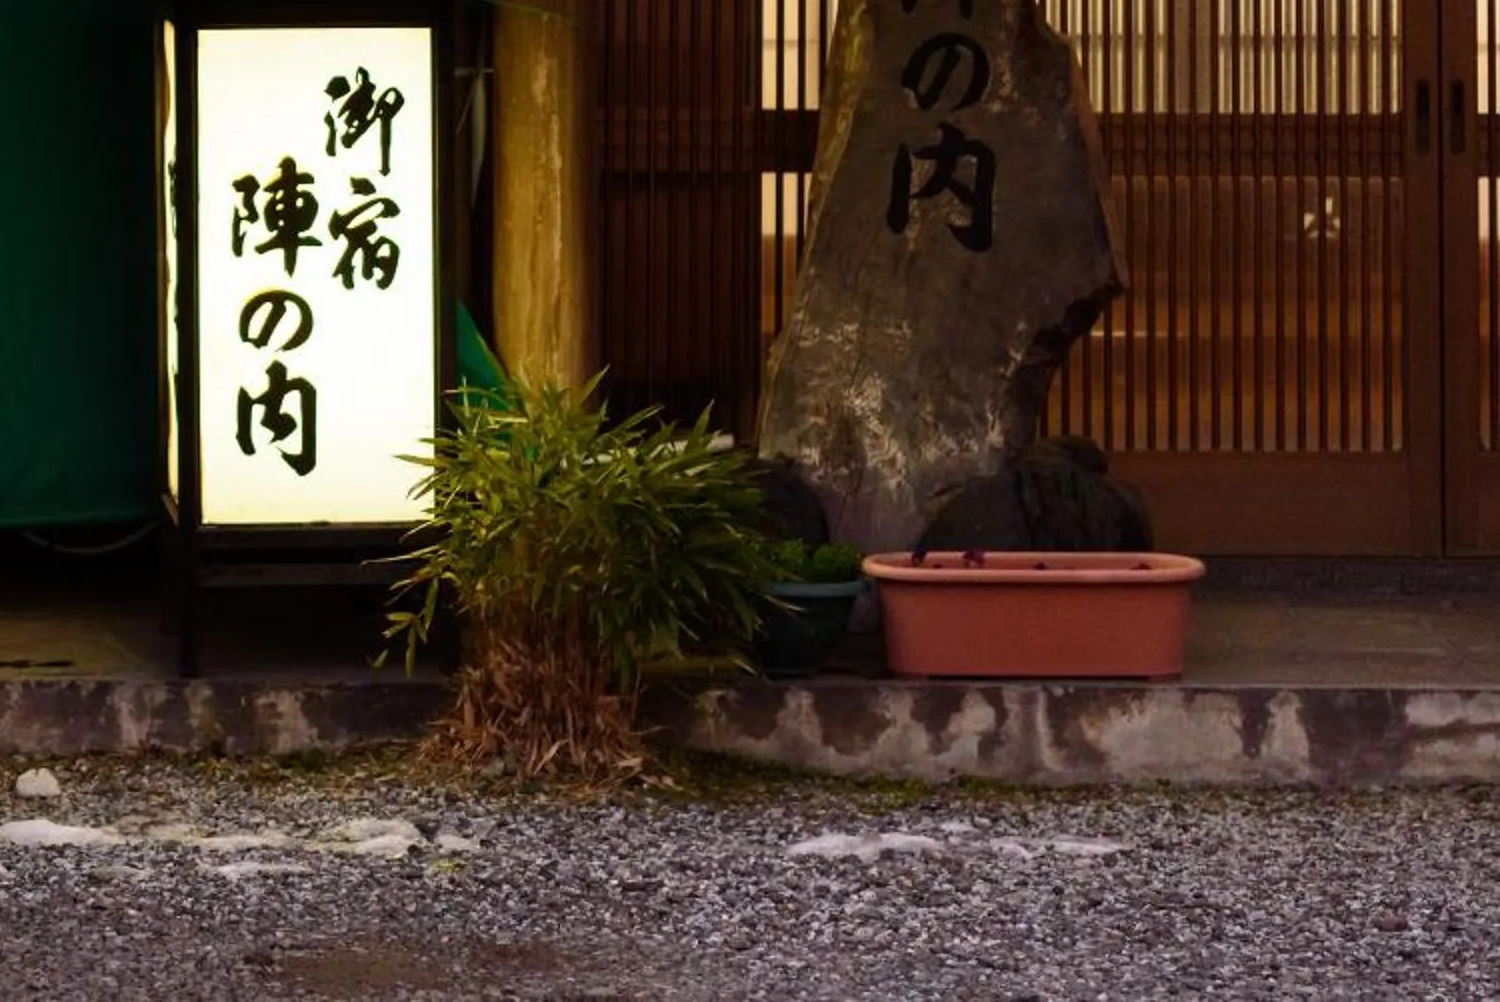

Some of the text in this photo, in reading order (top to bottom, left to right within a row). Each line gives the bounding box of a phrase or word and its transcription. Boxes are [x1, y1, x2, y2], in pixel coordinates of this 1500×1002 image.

[324, 66, 405, 290] 御宿
[231, 156, 323, 477] 陣の内
